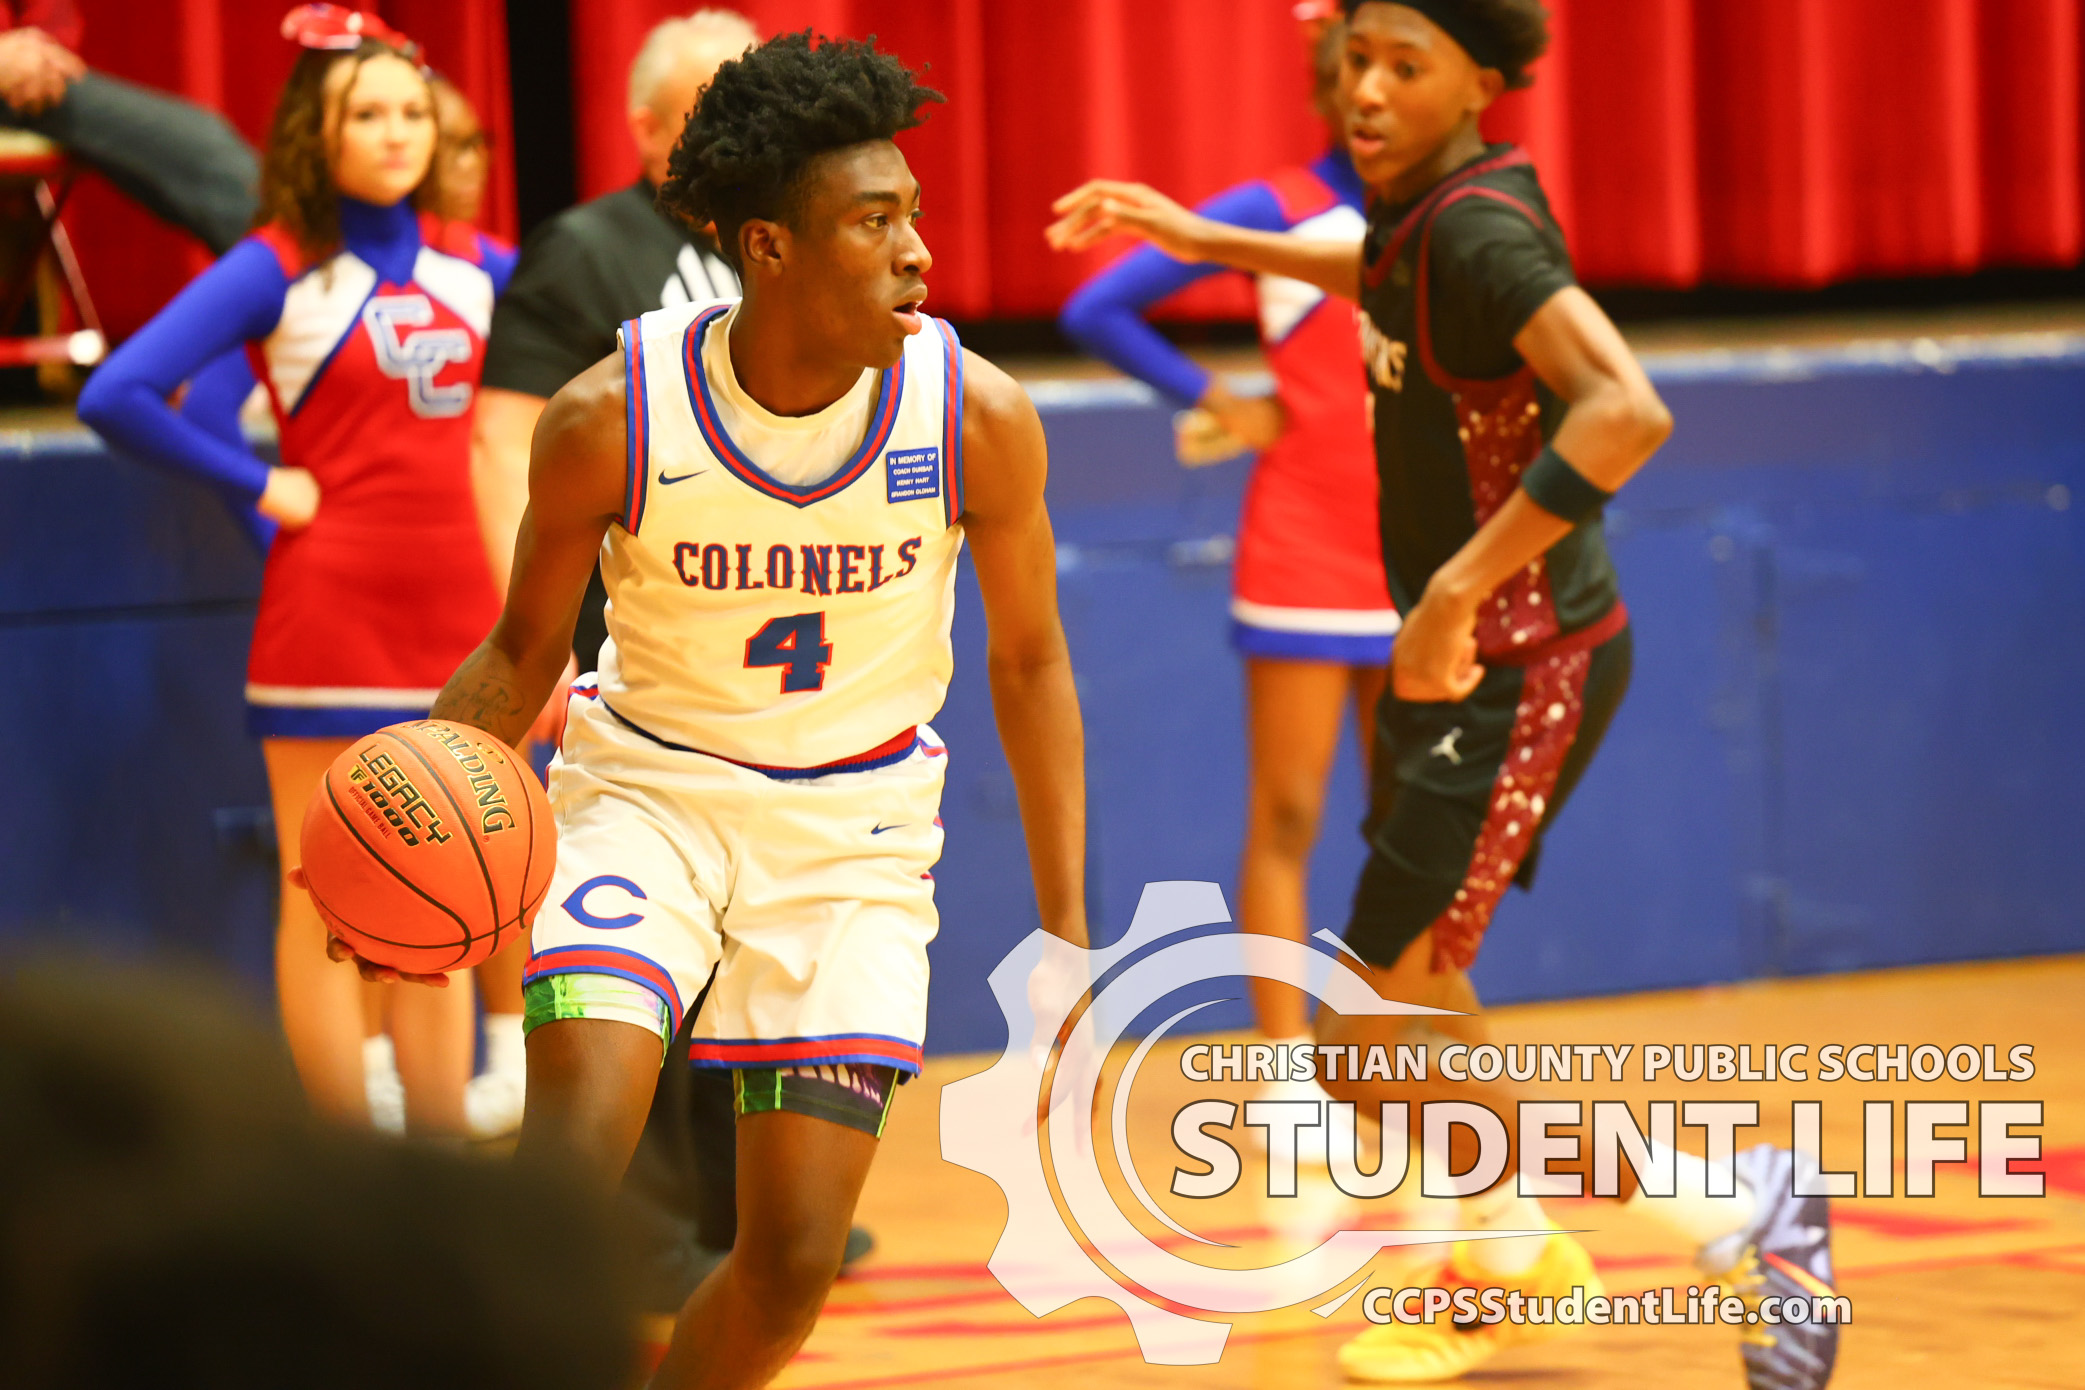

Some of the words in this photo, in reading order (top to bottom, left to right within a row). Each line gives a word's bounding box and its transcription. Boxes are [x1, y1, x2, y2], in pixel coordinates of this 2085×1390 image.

[893, 467, 911, 475] COACH
[912, 465, 933, 473] DUNBAR
[898, 454, 925, 464] MEMORY
[927, 453, 936, 461] OF
[672, 536, 922, 597] COLONELS
[743, 611, 833, 694] 4
[348, 786, 368, 809] OFFICIAL
[366, 806, 380, 825] GAME
[377, 822, 391, 839] BALL
[358, 744, 453, 845] LEGACY
[361, 781, 420, 846] 1000
[561, 875, 647, 929] C
